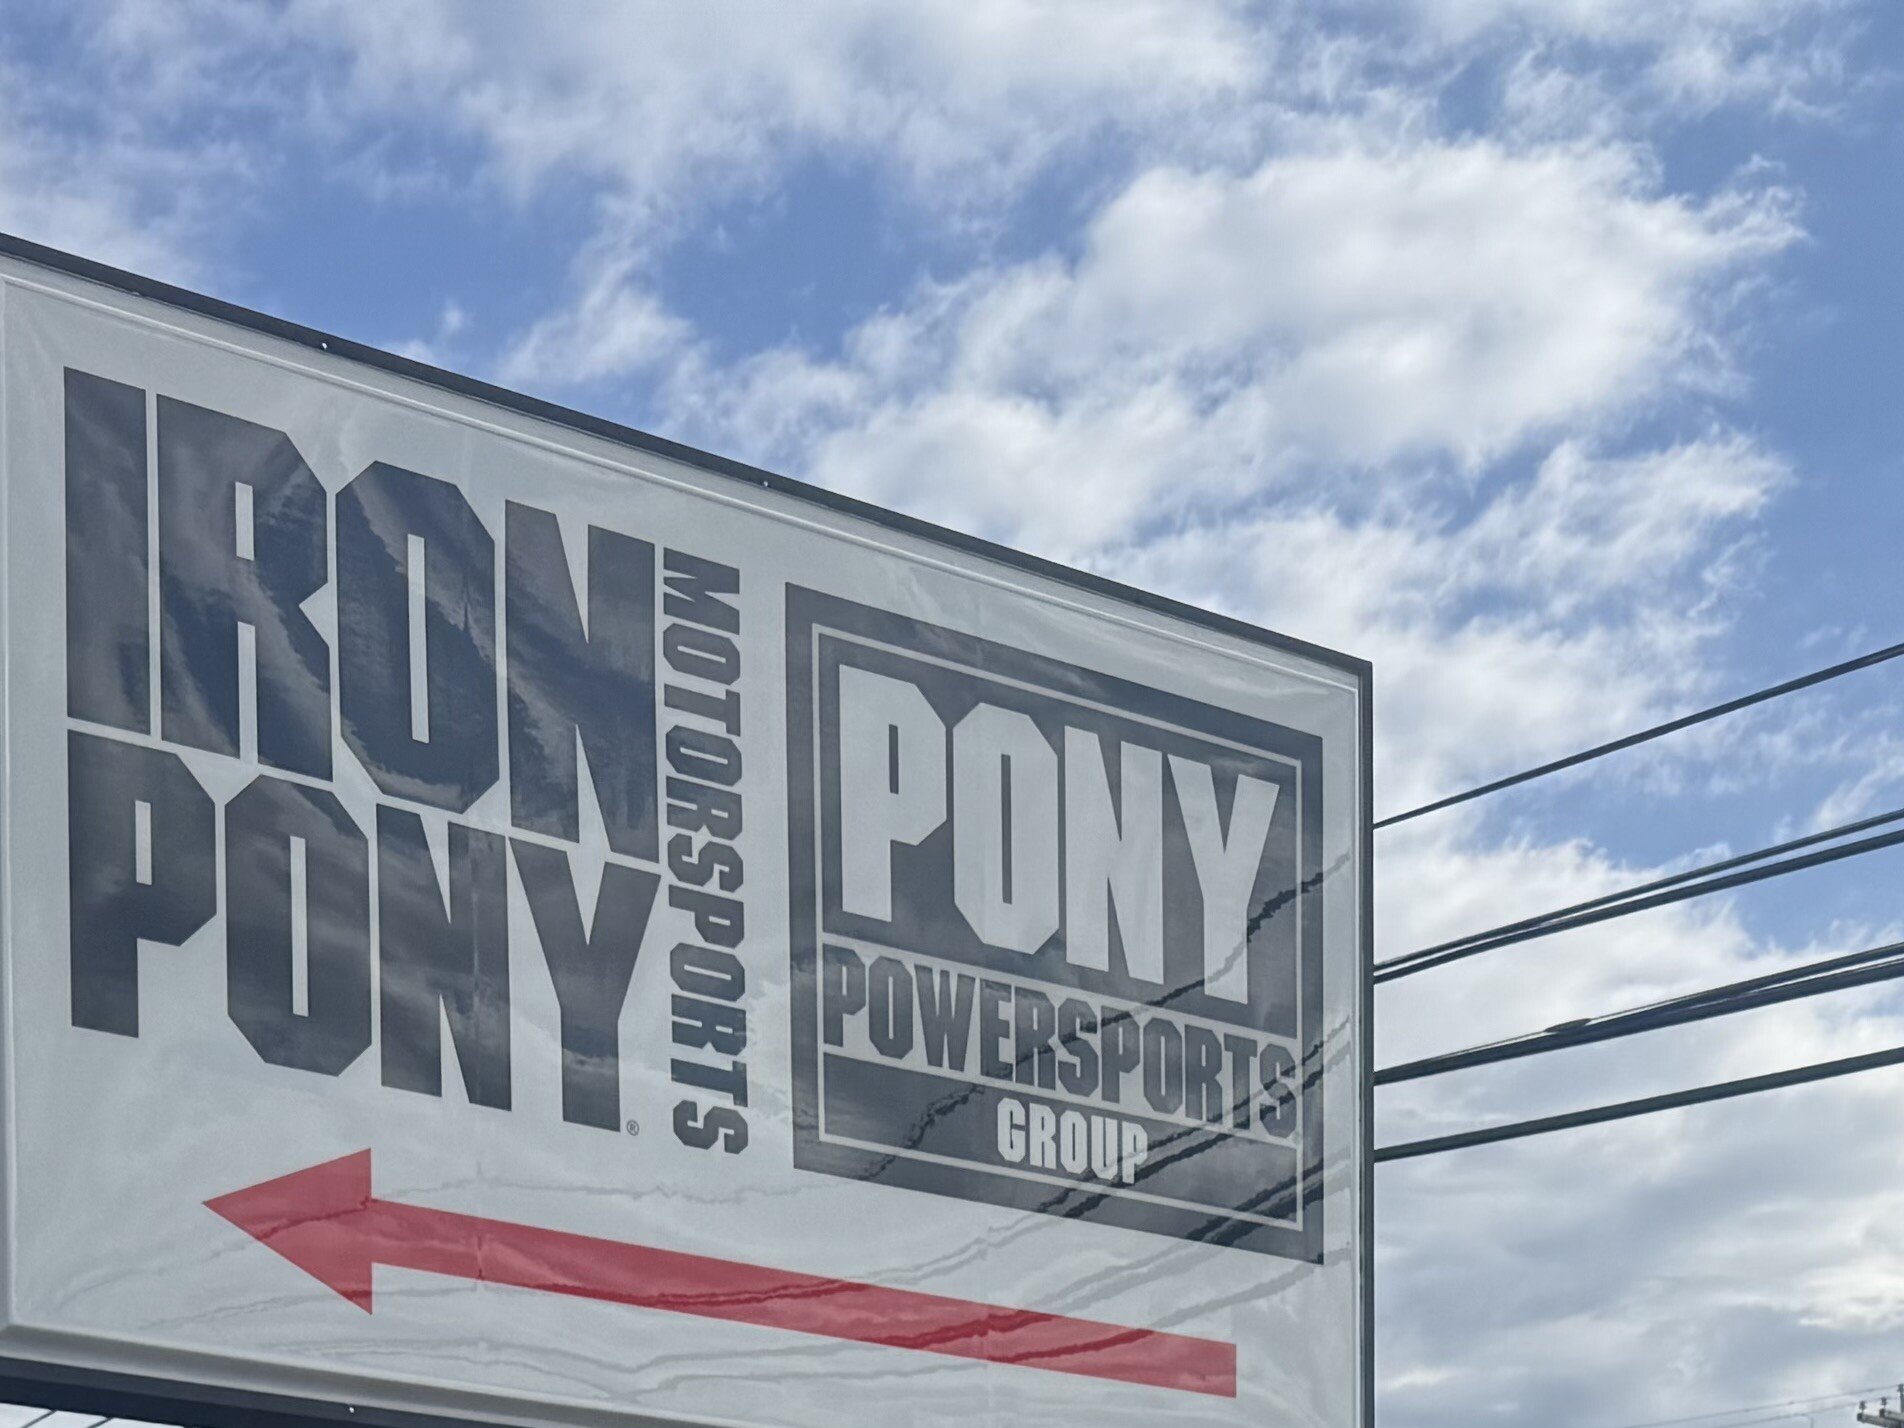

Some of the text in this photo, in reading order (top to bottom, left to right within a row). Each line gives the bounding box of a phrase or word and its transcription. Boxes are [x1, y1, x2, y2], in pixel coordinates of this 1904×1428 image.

[64, 366, 657, 861] IRON
[66, 728, 661, 1132] PONY
[660, 547, 749, 1157] MOTORSPORTS
[838, 663, 1281, 1003] PONY
[822, 946, 1296, 1141] POWERSPORTS
[995, 1096, 1149, 1185] GROUP
